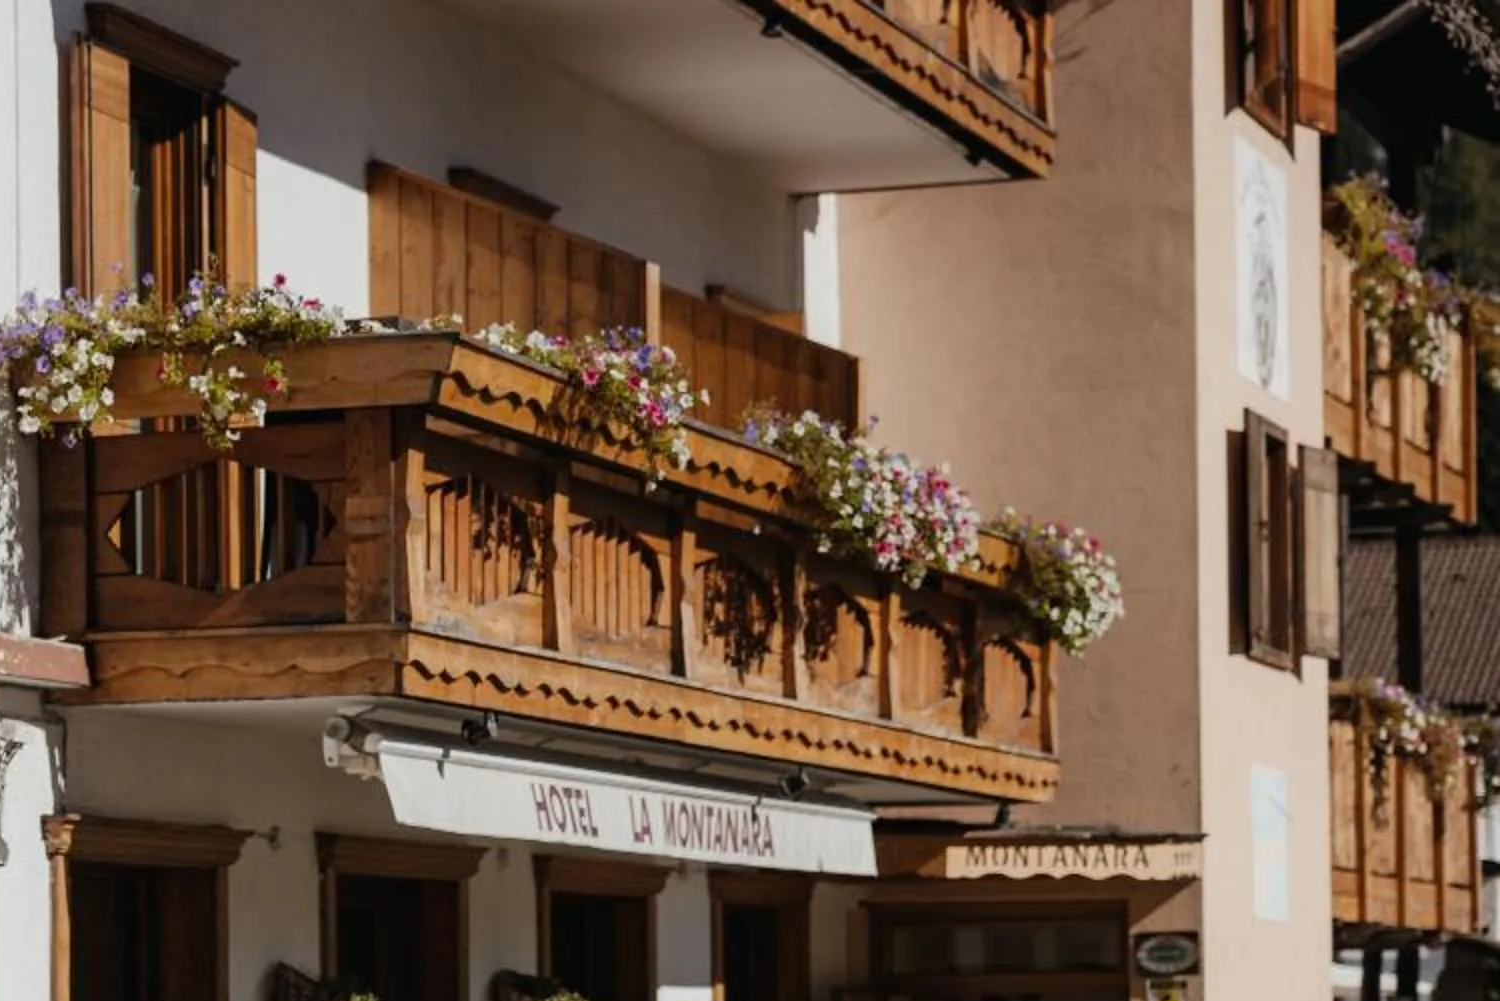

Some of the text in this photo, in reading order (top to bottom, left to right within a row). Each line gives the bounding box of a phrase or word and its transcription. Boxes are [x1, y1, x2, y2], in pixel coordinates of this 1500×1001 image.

[531, 783, 775, 857] HOTEL LA MONTANARA
[965, 845, 1149, 869] MONTANARA
